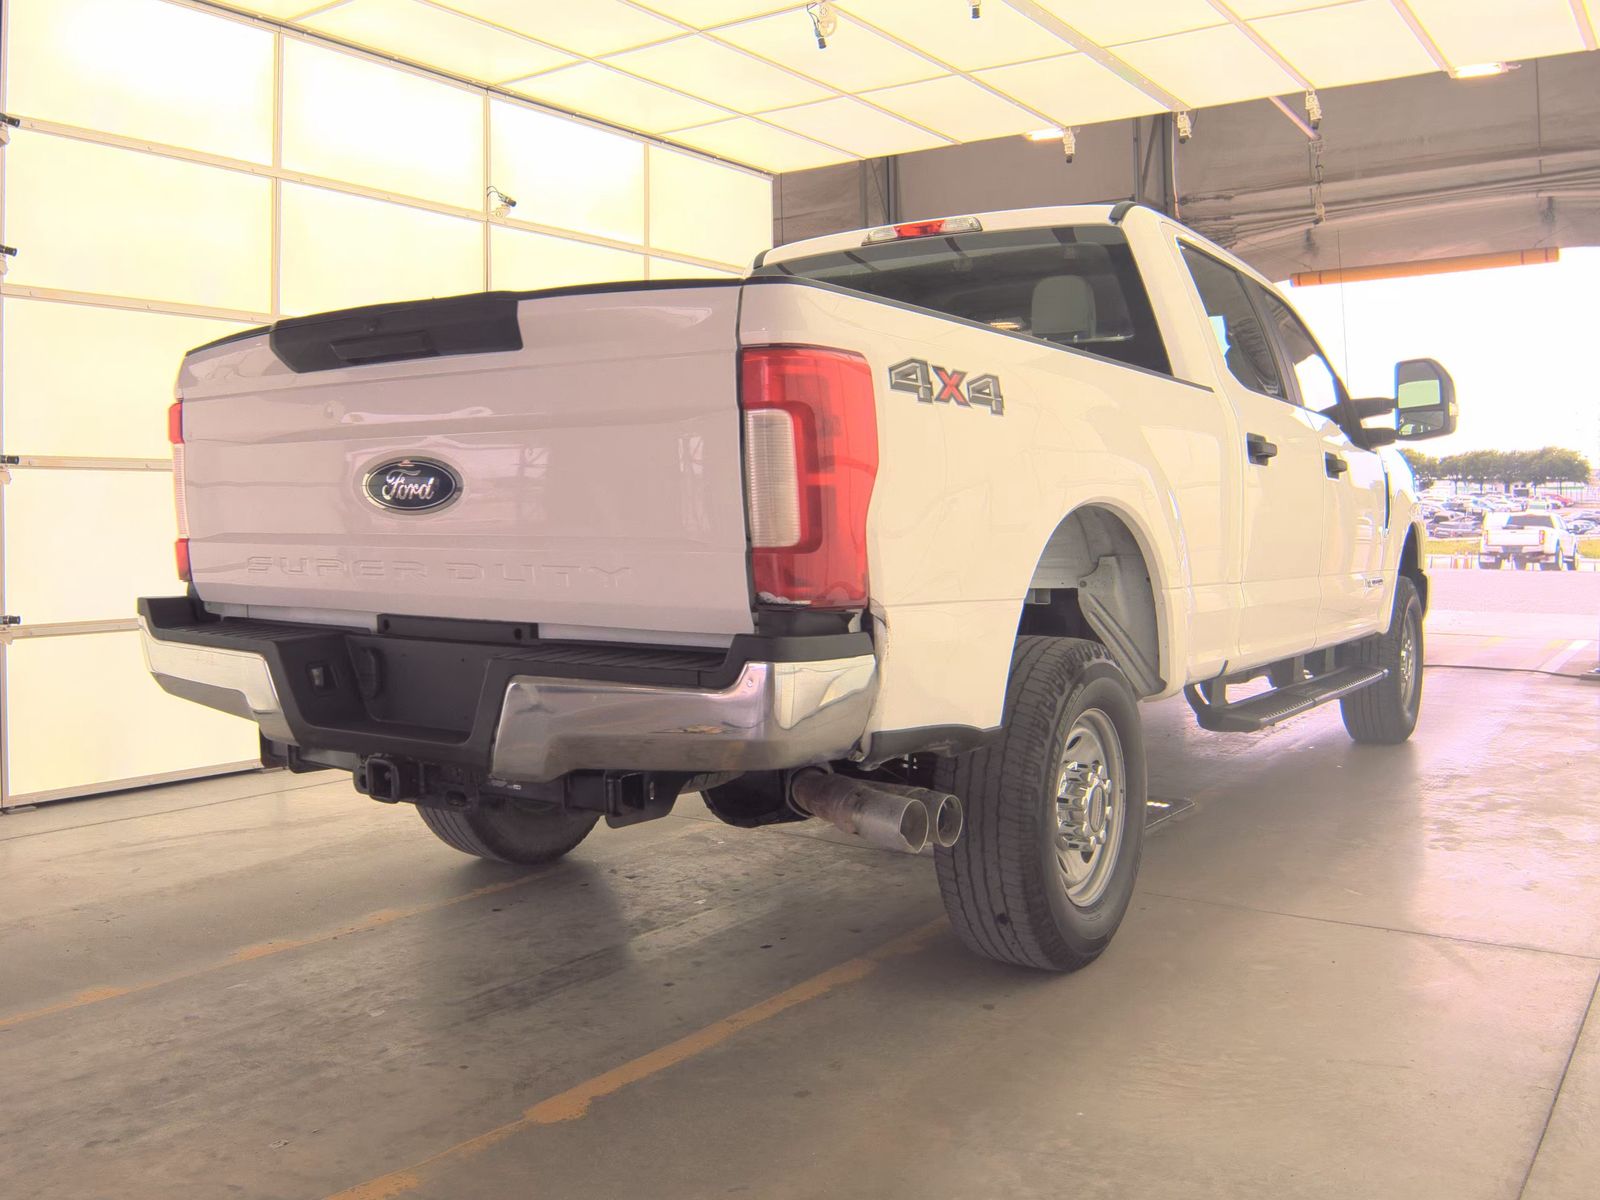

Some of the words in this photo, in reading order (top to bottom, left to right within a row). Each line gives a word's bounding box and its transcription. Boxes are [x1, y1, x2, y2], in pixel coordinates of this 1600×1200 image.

[888, 358, 1004, 416] 4X4
[382, 469, 434, 500] Ford
[246, 555, 429, 579] SUPER
[443, 561, 632, 588] DUTY
